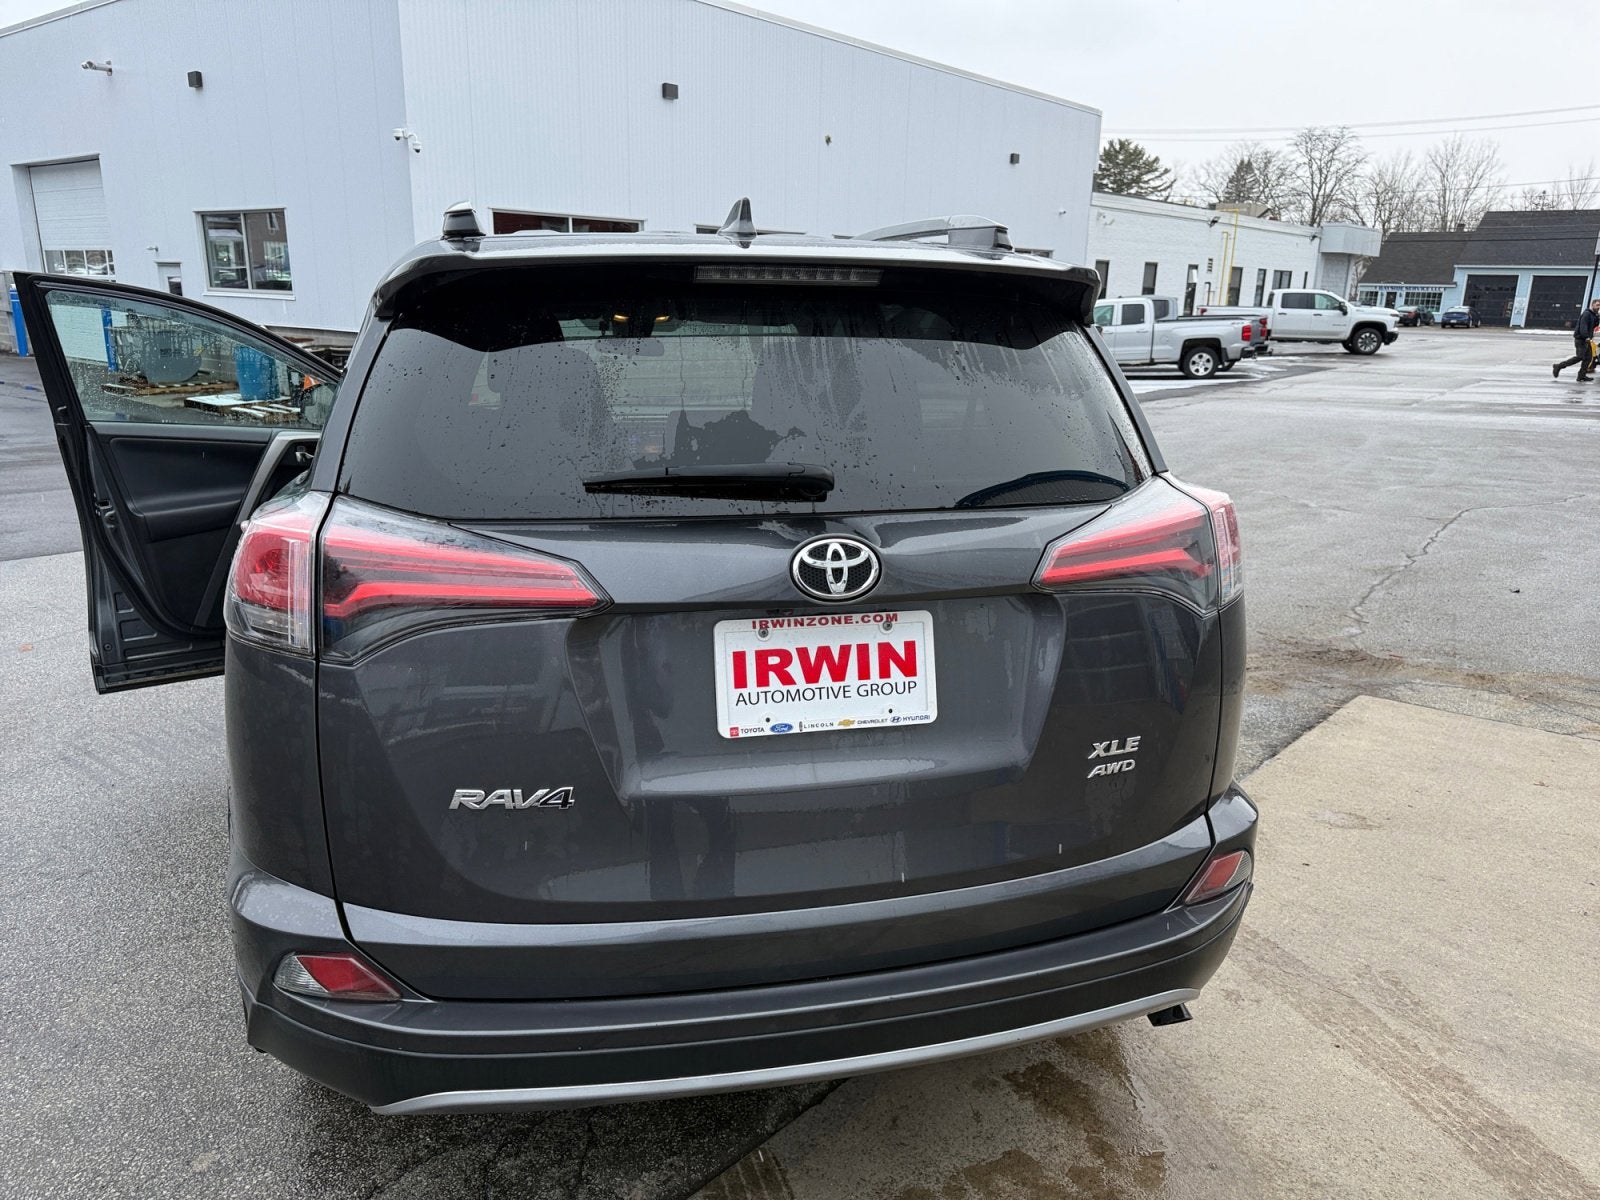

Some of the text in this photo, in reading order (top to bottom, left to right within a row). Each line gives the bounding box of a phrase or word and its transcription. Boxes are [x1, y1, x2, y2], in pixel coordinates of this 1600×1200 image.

[752, 613, 898, 630] IRWINZONE.COM
[732, 640, 918, 689] IRWIN
[735, 681, 918, 706] AUTOMOTIVE GROUP
[773, 724, 790, 732] Ford
[1087, 736, 1141, 759] XLE
[1087, 759, 1136, 778] AWD
[448, 786, 575, 810] RAV4
